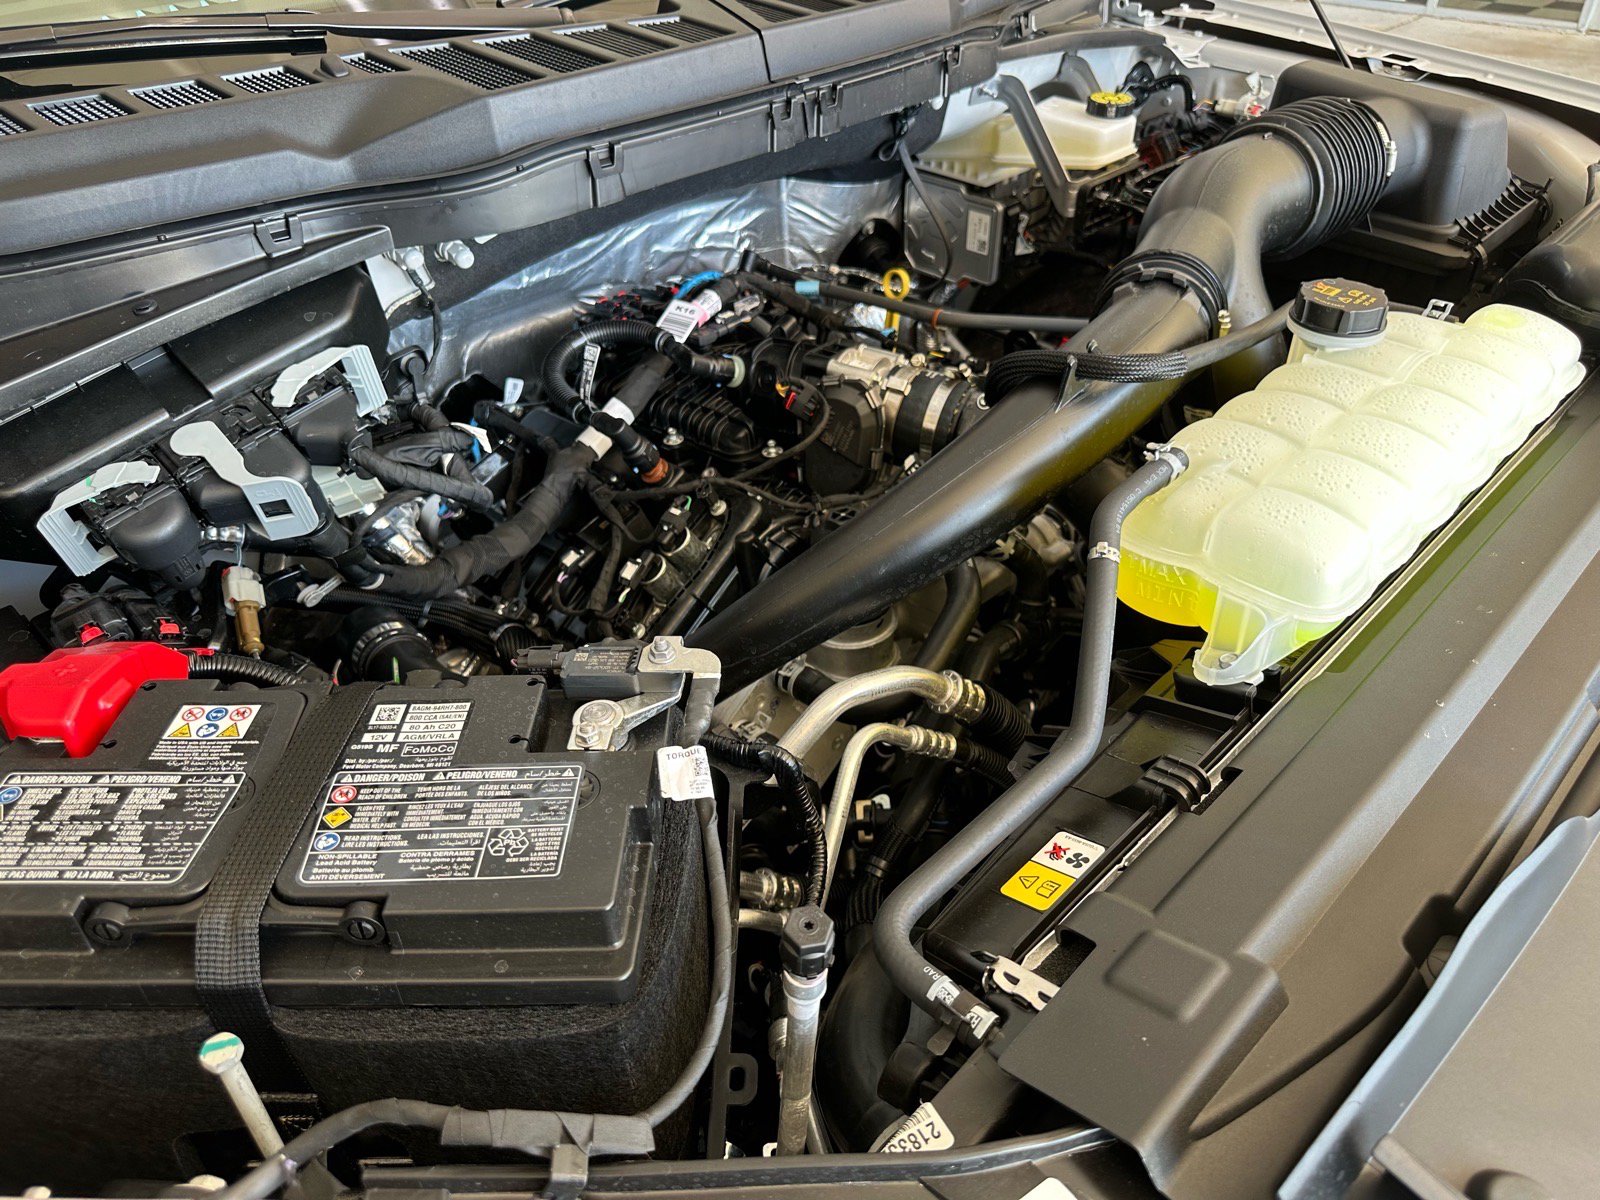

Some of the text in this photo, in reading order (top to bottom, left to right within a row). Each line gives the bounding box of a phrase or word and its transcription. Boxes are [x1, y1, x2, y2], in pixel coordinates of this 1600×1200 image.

[675, 305, 696, 316] K16
[376, 743, 400, 753] MF
[404, 745, 455, 754] FoMoCo
[666, 748, 701, 760] TORQUE
[111, 775, 181, 783] PELIGRO/VENENO
[354, 773, 426, 782] DANGER/POISON
[446, 770, 517, 779] PELIGRO/VENENO
[21, 776, 93, 784] DANGER/POISON
[923, 966, 940, 980] RAD
